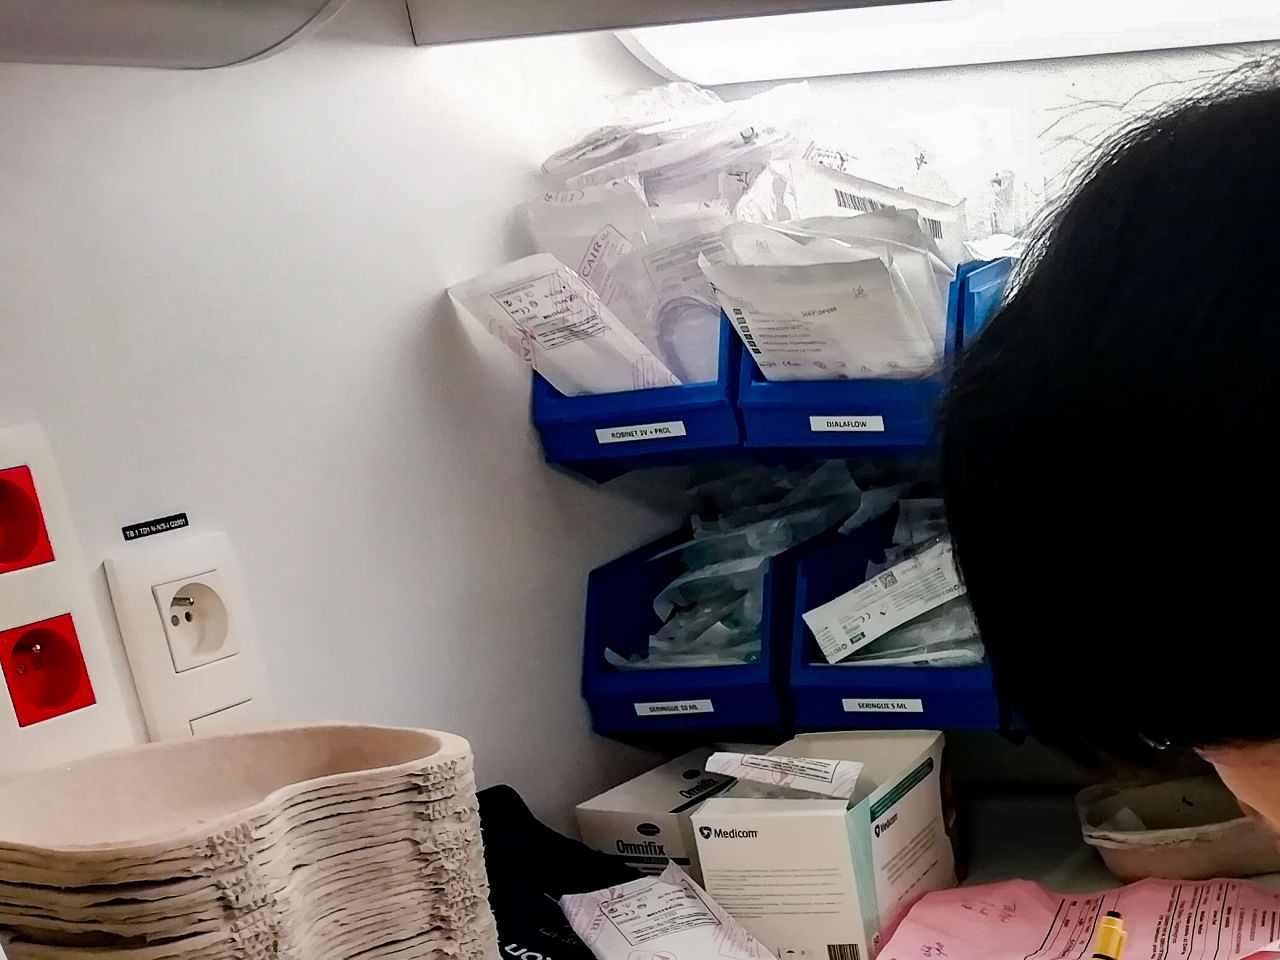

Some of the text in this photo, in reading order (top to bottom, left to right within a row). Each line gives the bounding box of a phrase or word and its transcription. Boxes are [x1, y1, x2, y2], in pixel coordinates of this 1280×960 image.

[582, 241, 602, 277] CAIR
[826, 420, 868, 428] DIALAFLOW
[611, 430, 638, 439] ROBINET
[648, 704, 680, 713] SERINGUE
[857, 702, 890, 710] SERINGUE
[680, 778, 719, 799] Omnifix
[714, 828, 758, 839] Medicom
[616, 840, 666, 856] Omnifix
